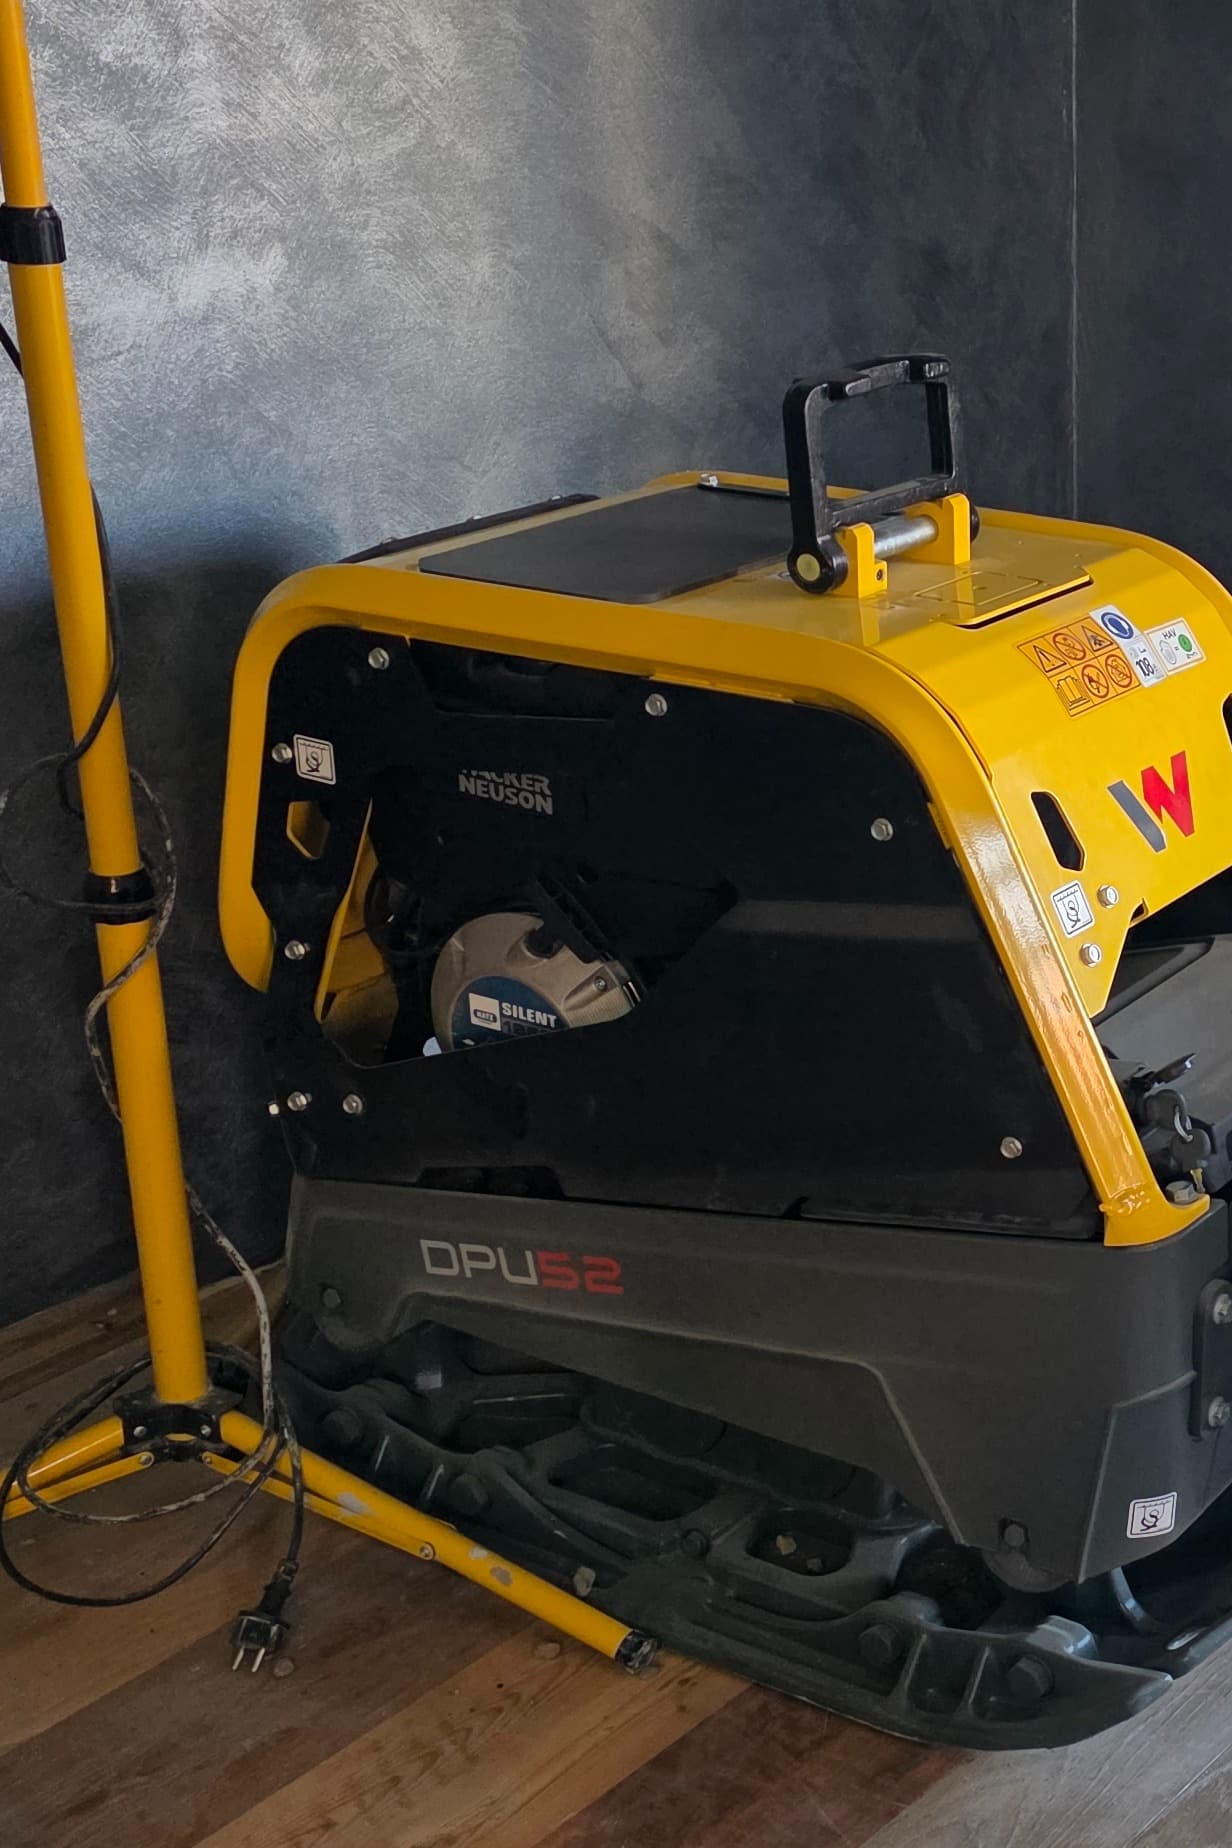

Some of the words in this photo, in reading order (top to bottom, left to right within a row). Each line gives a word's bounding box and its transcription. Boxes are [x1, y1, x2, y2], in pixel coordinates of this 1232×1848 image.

[458, 774, 553, 816] NEUSON
[501, 1002, 557, 1028] SILENT
[419, 1239, 624, 1296] DPU52
